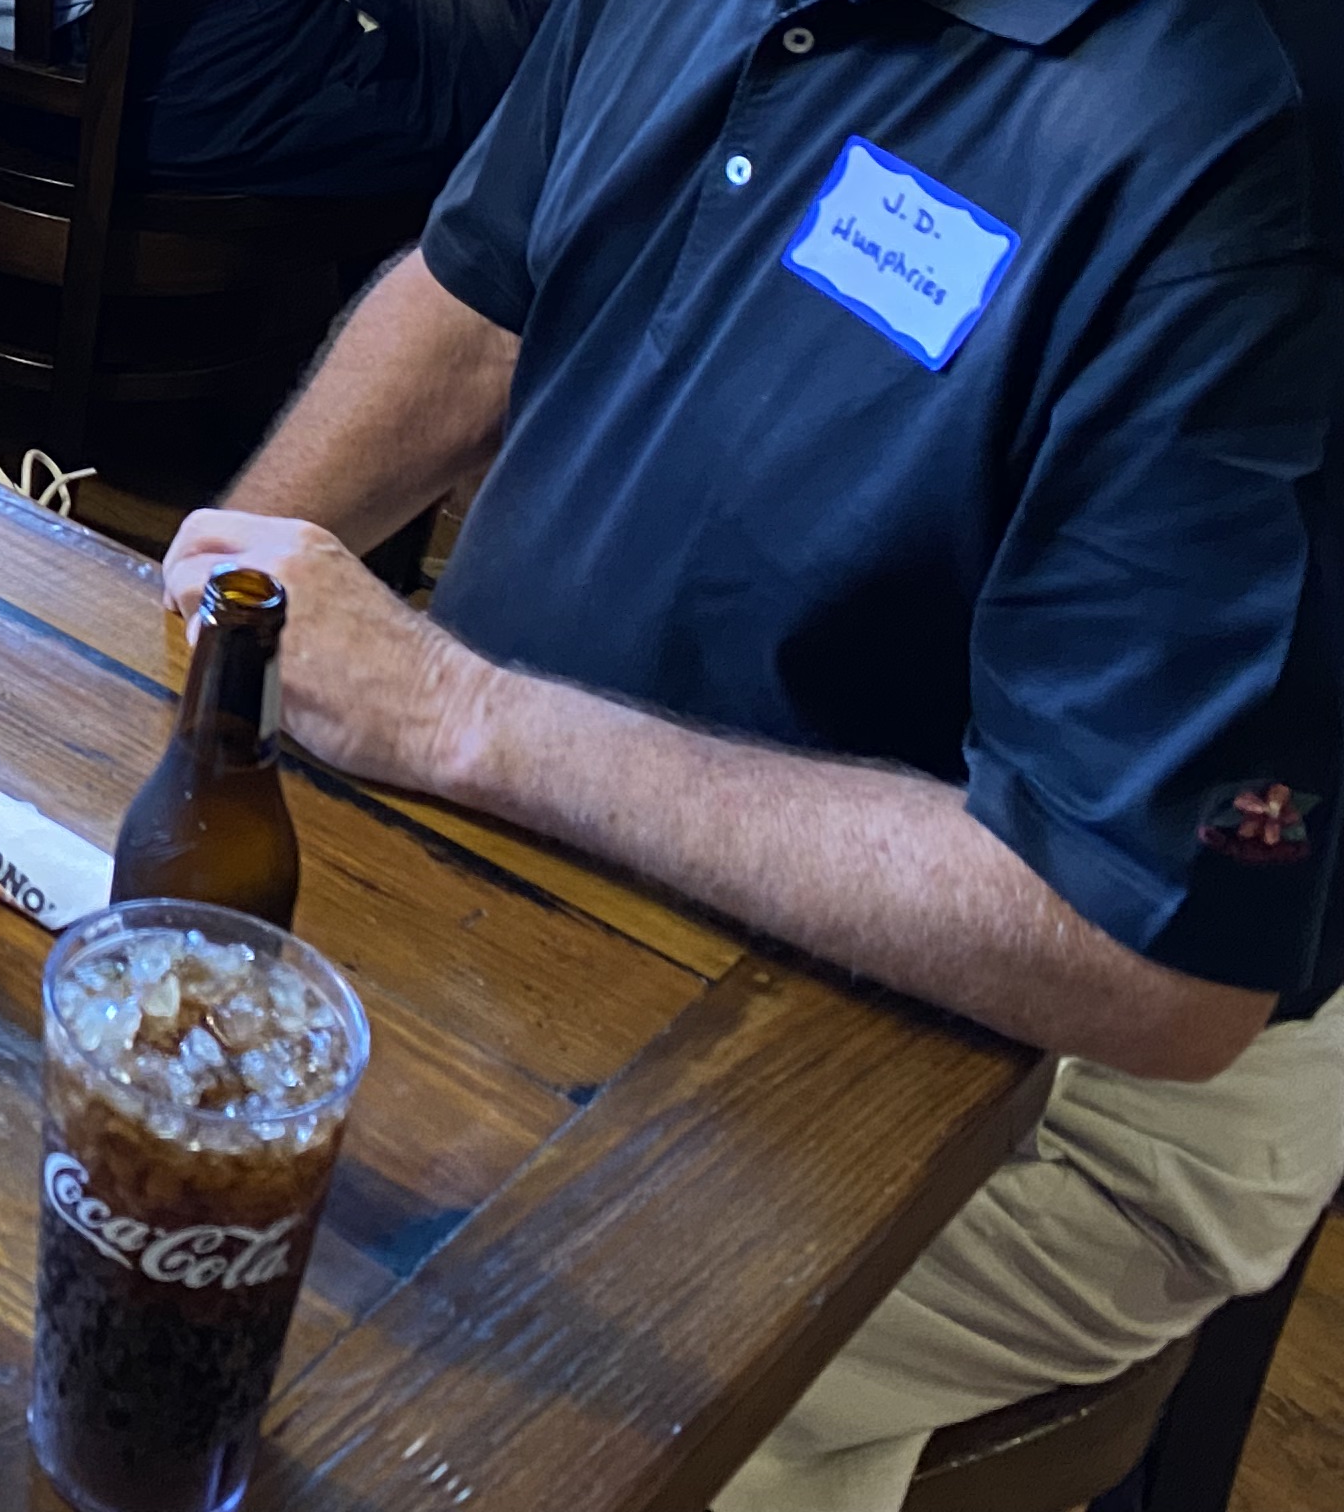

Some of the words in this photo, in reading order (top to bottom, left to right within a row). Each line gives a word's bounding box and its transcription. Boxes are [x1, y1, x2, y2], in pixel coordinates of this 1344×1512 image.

[830, 215, 948, 306] Humphries
[882, 192, 907, 221] J.
[913, 209, 941, 240] D.
[44, 1152, 302, 1289] Coca-Cola
